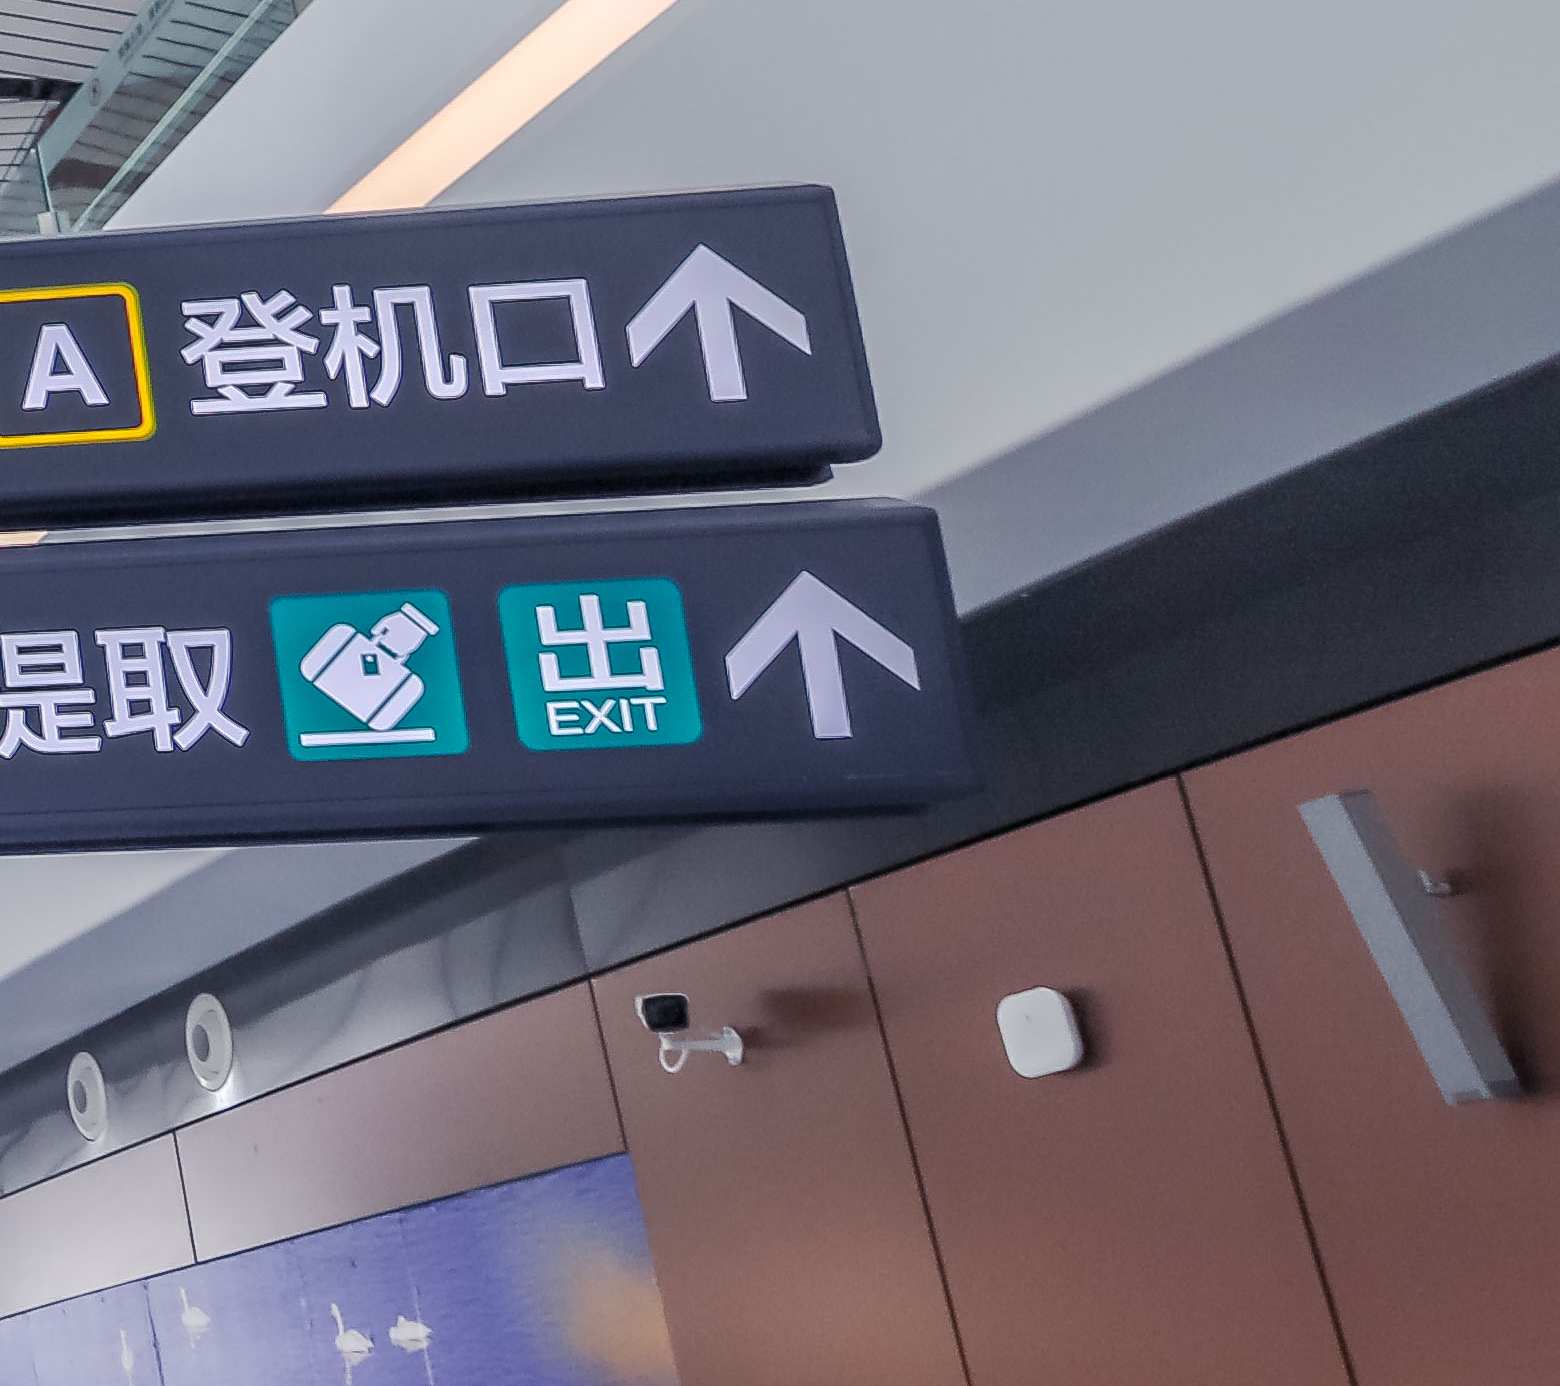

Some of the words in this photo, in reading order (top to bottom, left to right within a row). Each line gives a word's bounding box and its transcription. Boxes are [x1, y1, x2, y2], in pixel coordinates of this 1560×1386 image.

[21, 322, 110, 412] A
[179, 277, 606, 416] 登机口
[534, 592, 666, 693] 出
[545, 695, 668, 737] EXIT
